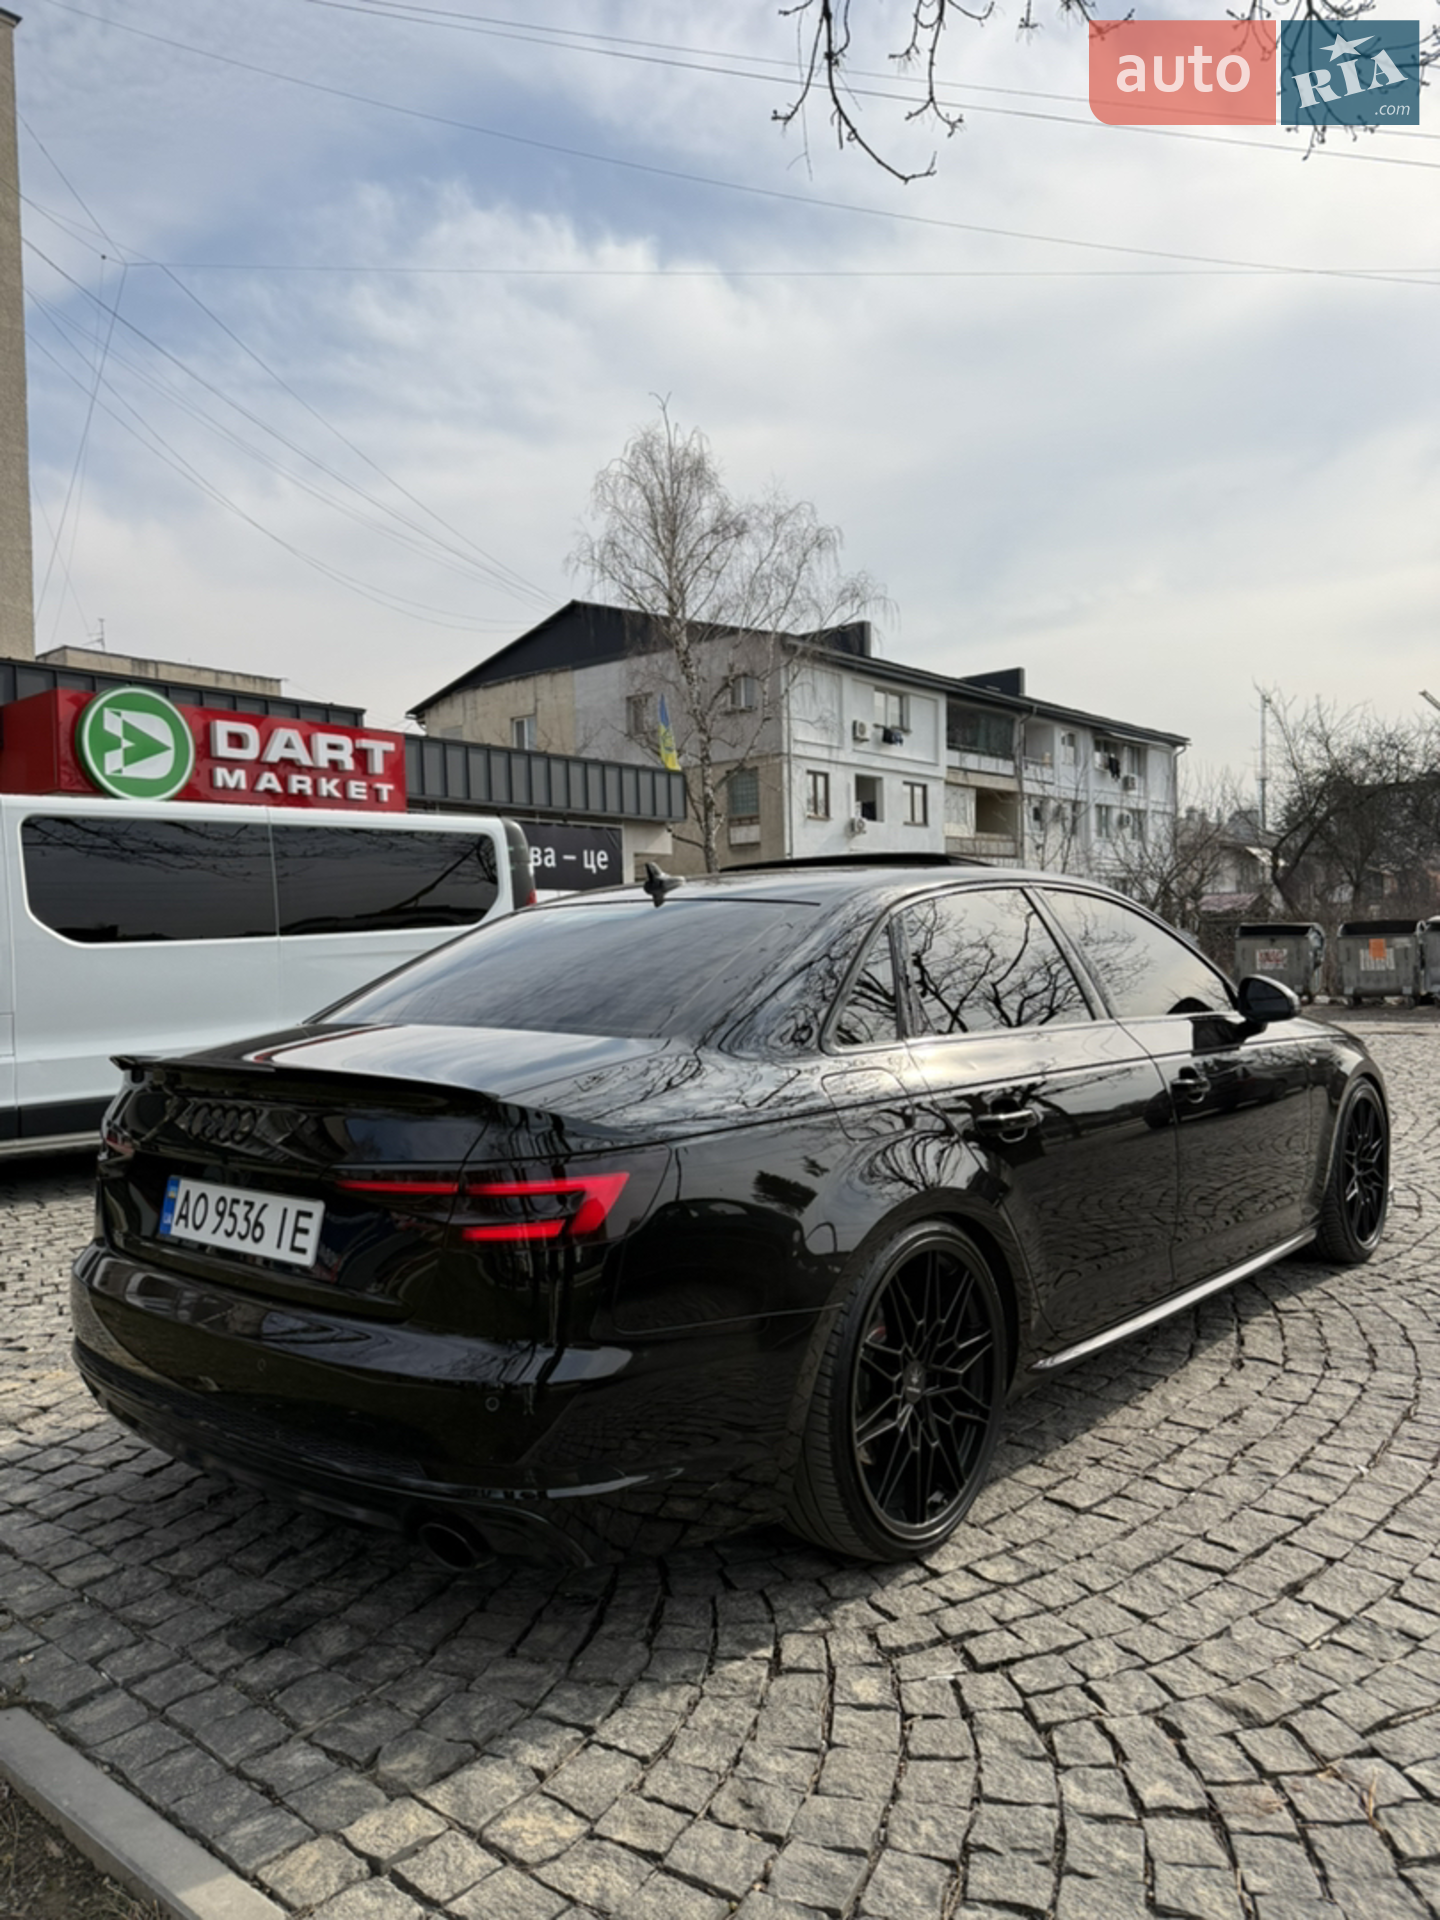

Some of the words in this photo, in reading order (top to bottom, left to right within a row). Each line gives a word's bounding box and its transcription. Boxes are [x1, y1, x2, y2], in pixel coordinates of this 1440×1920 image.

[210, 719, 396, 775] DART
[213, 766, 395, 802] MARKET
[583, 849, 609, 874] це
[175, 1189, 209, 1231] AO
[211, 1196, 269, 1243] 9536
[276, 1207, 314, 1255] IE
